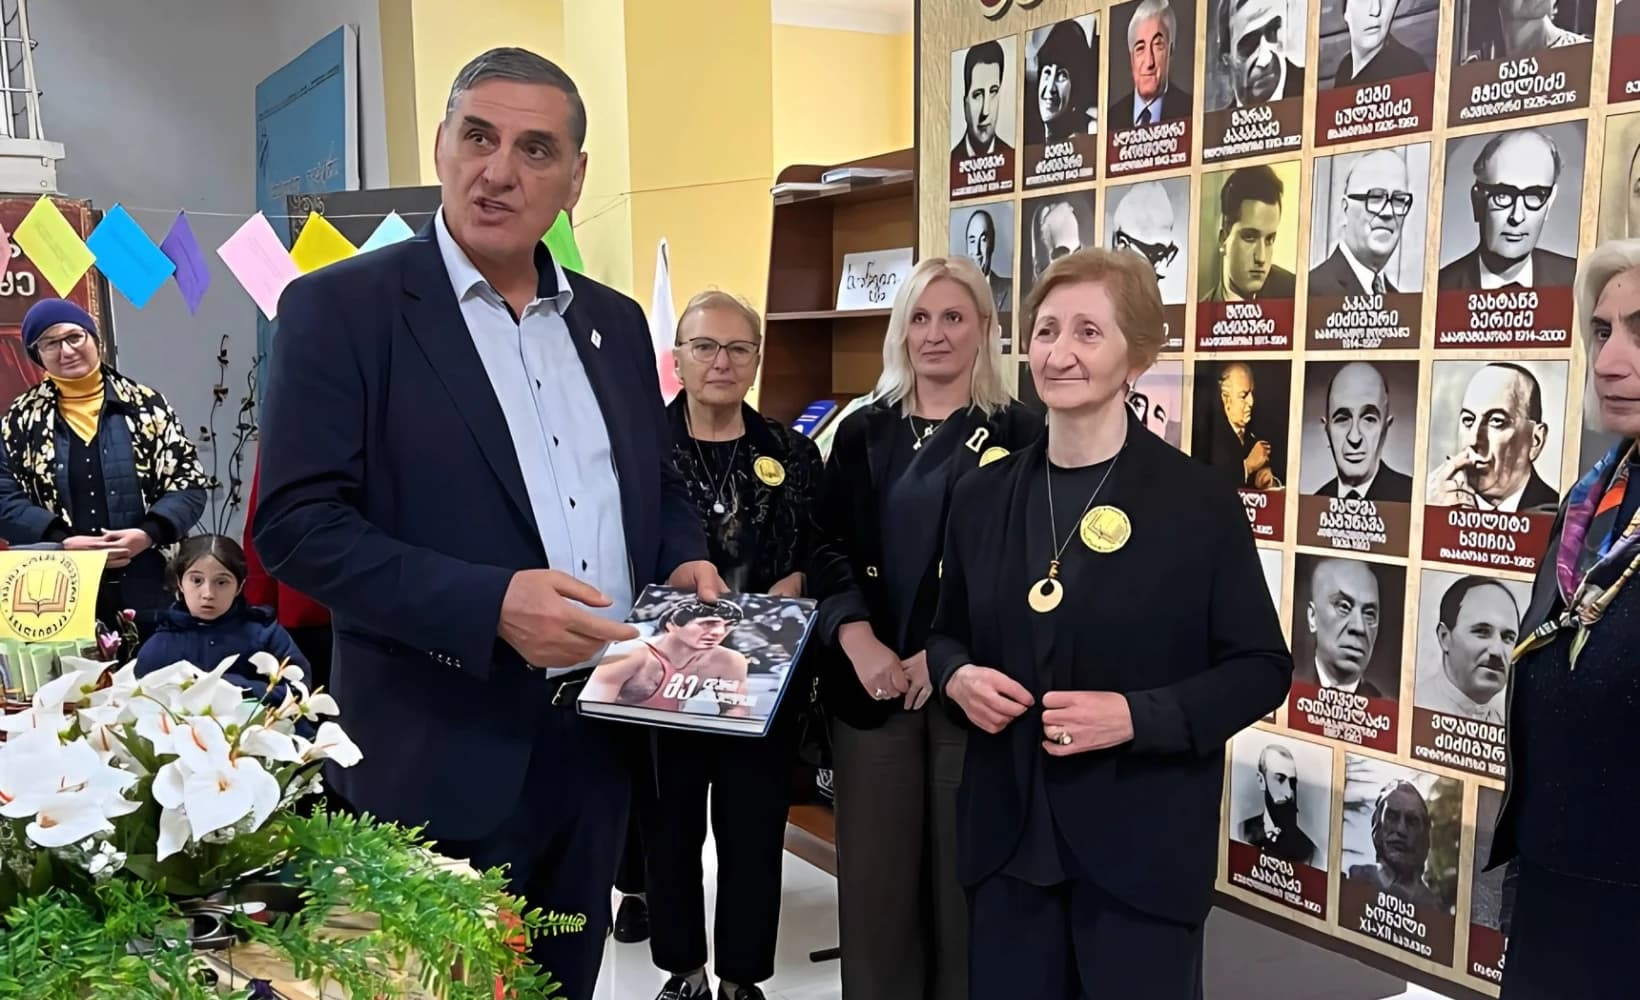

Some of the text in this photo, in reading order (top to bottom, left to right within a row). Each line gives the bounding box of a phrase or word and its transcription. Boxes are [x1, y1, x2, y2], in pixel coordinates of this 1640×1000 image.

[1499, 57, 1539, 79] ნანა
[1471, 71, 1566, 103] მჭედლიძე
[1226, 304, 1262, 319] შოთა
[1342, 294, 1383, 311] აკაკი
[1468, 292, 1538, 310] ვახტანგ
[1213, 319, 1275, 335] ძიძიგური
[1326, 310, 1399, 327] ძიძიგური
[1470, 310, 1534, 328] ბერიძე
[1329, 497, 1376, 515] შალვა
[1448, 510, 1530, 533] იპოლიტე
[1459, 530, 1516, 551] ხვიჩია
[663, 672, 699, 699] მე
[1318, 688, 1369, 711] იოველ
[1297, 697, 1390, 731] ქუთათელაძე
[1434, 733, 1505, 762] ძიძიგურ
[1260, 854, 1294, 876] ილია
[1377, 891, 1415, 918] მოსე
[1365, 904, 1426, 938] ხონელი
